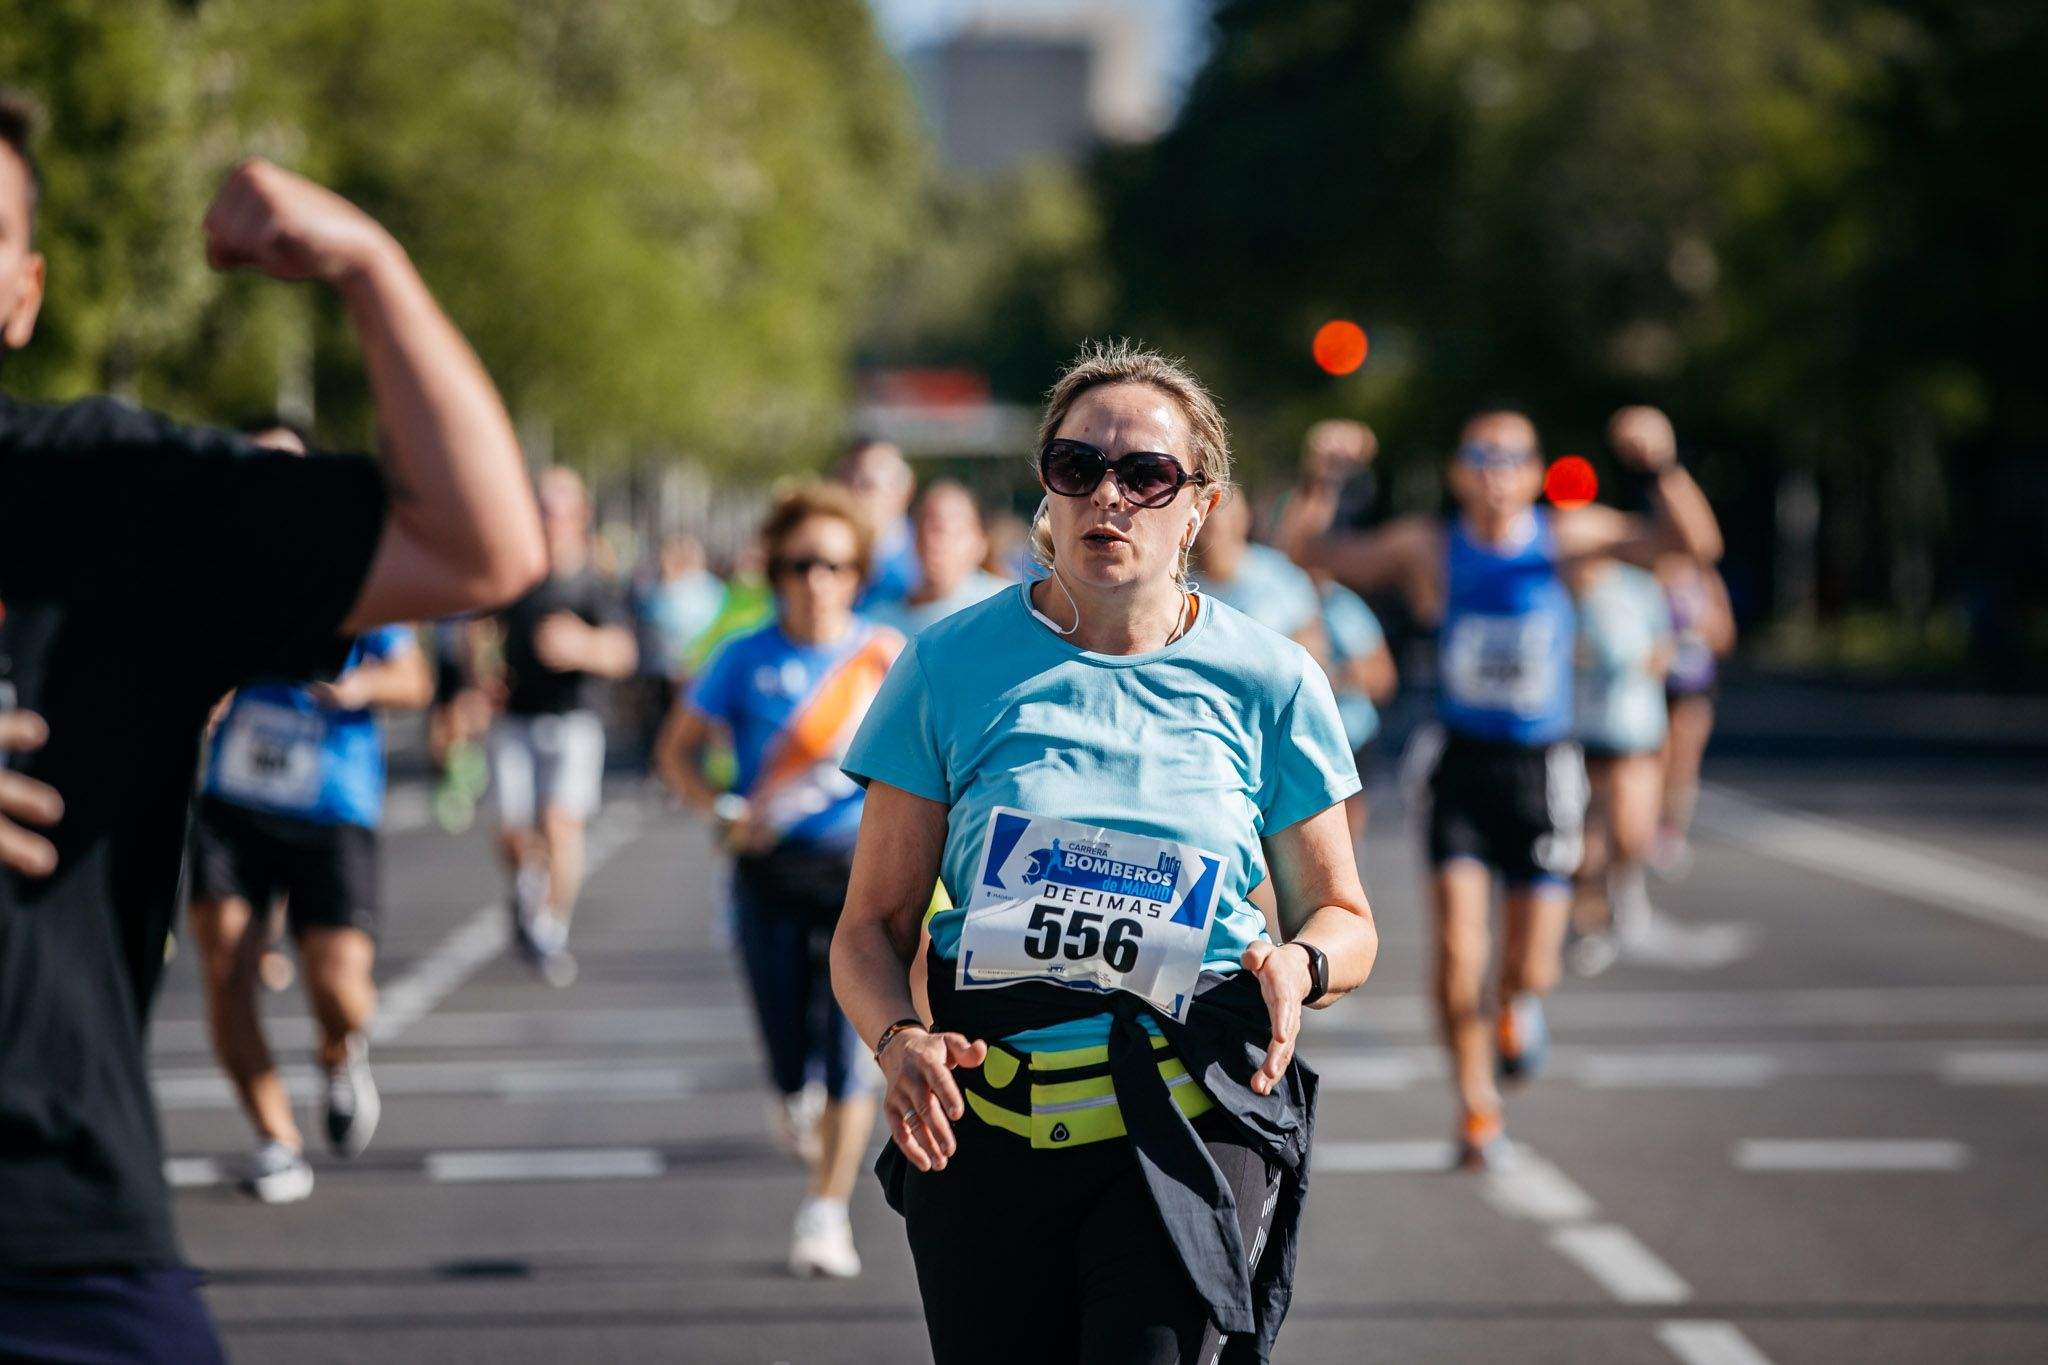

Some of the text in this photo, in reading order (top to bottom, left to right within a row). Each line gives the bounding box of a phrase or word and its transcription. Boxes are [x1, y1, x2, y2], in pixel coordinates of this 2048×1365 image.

[1069, 843, 1108, 857] CARRERA
[1064, 852, 1173, 887] BOMBEROS
[1043, 884, 1162, 919] DECIMAS
[1102, 877, 1170, 901] de MADRID
[1024, 903, 1143, 973] 556
